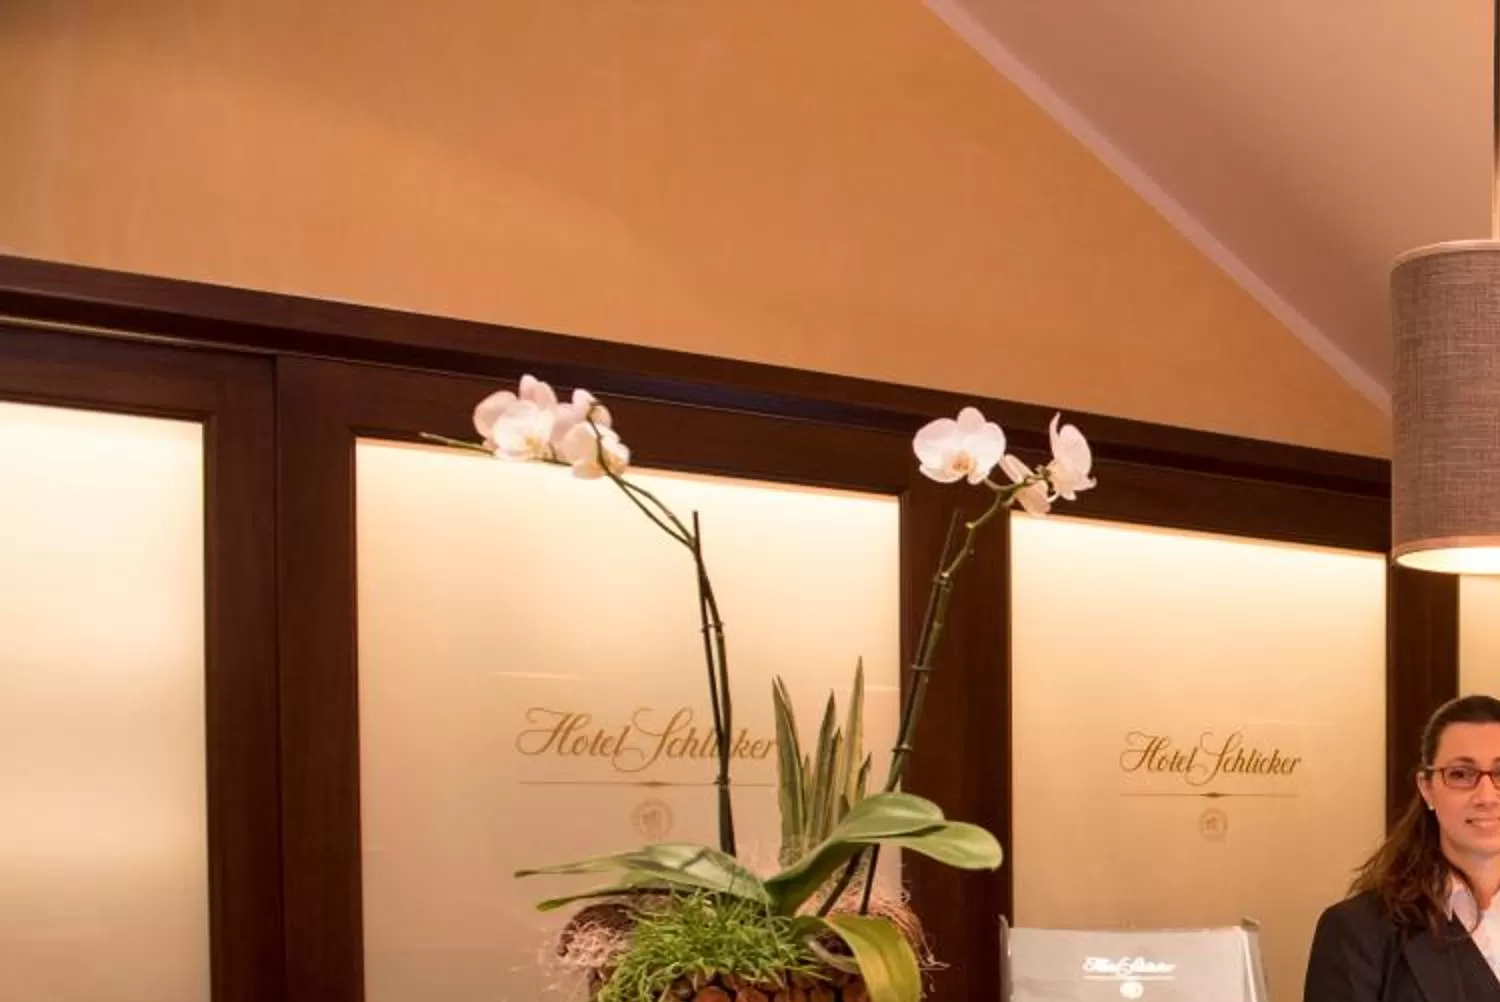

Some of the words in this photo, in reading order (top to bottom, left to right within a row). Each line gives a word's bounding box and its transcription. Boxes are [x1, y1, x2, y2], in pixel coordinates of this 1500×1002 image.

[515, 707, 630, 757] Hotel
[611, 707, 777, 772] Schliker
[1119, 731, 1199, 773] Hotel
[1184, 731, 1302, 787] Schlicker
